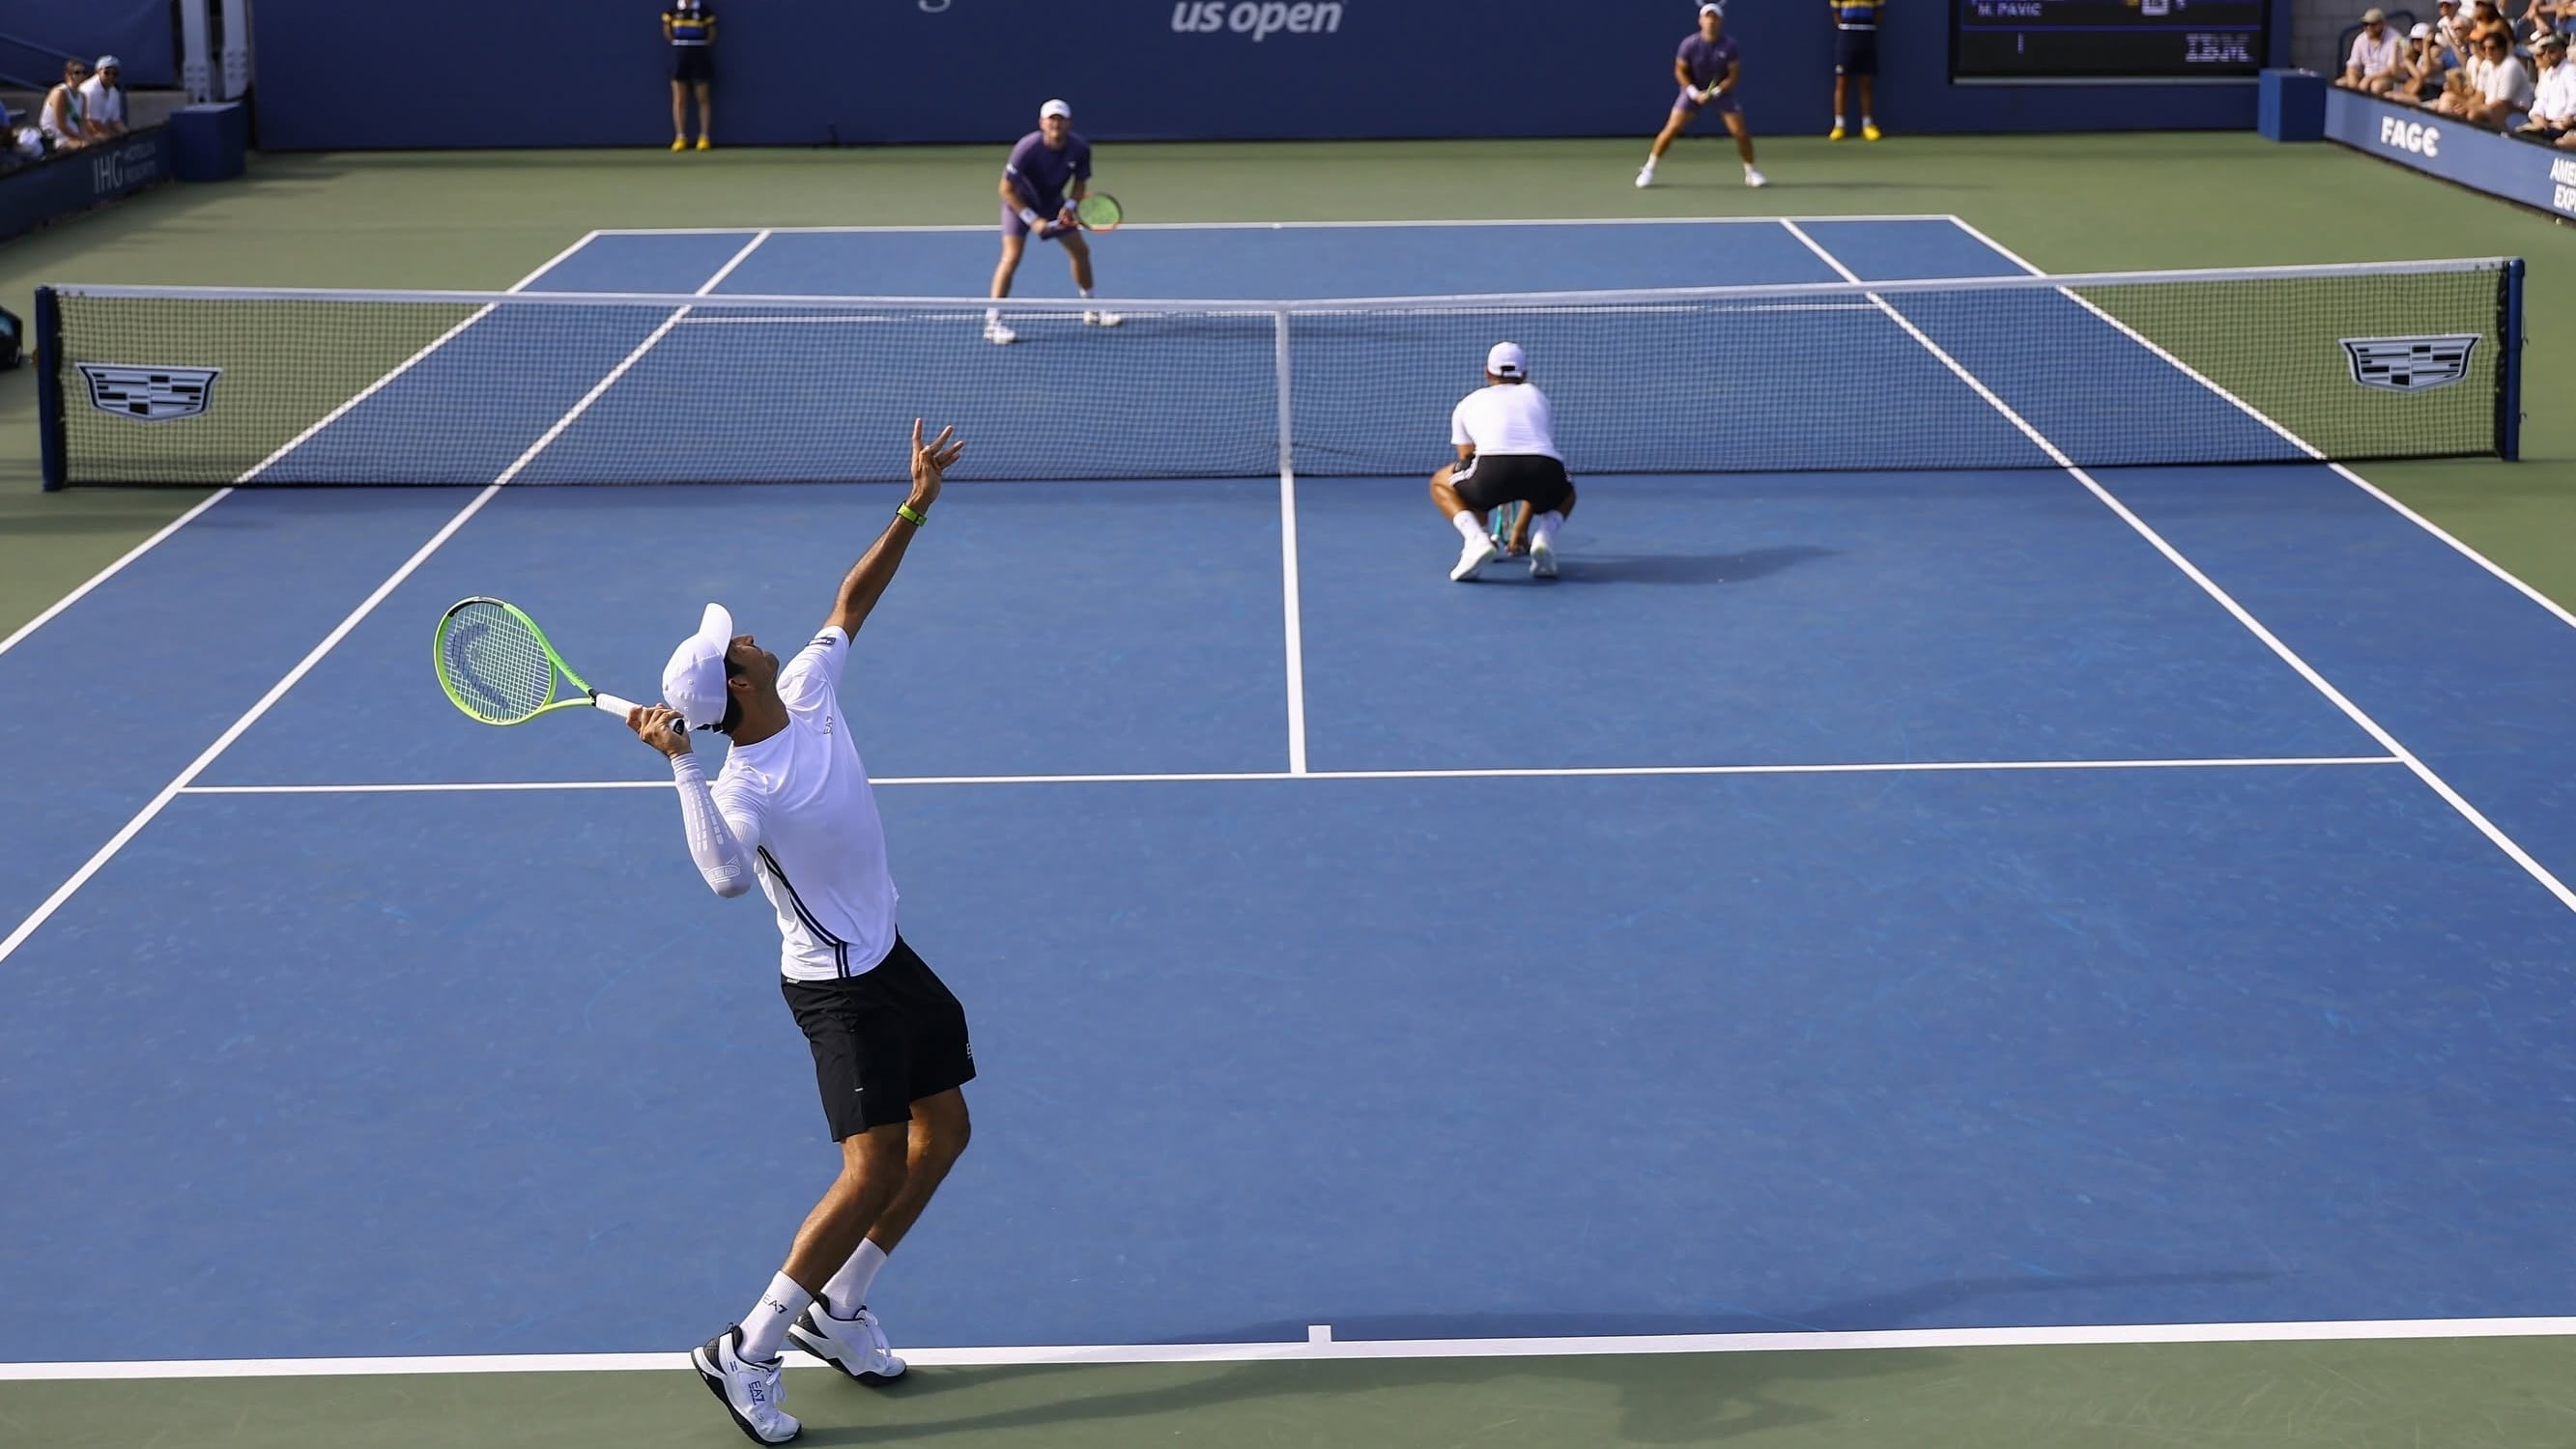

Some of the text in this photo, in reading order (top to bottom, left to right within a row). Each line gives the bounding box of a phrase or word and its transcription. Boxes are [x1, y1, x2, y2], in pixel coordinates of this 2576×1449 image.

[1171, 1, 1344, 42] us open
[2186, 33, 2252, 63] IBM
[2380, 115, 2441, 158] FAGE
[94, 150, 124, 194] IHG
[2549, 157, 2576, 187] AME
[2553, 183, 2576, 213] EXP
[763, 1293, 788, 1315] EA7
[751, 1380, 766, 1402] EA7
